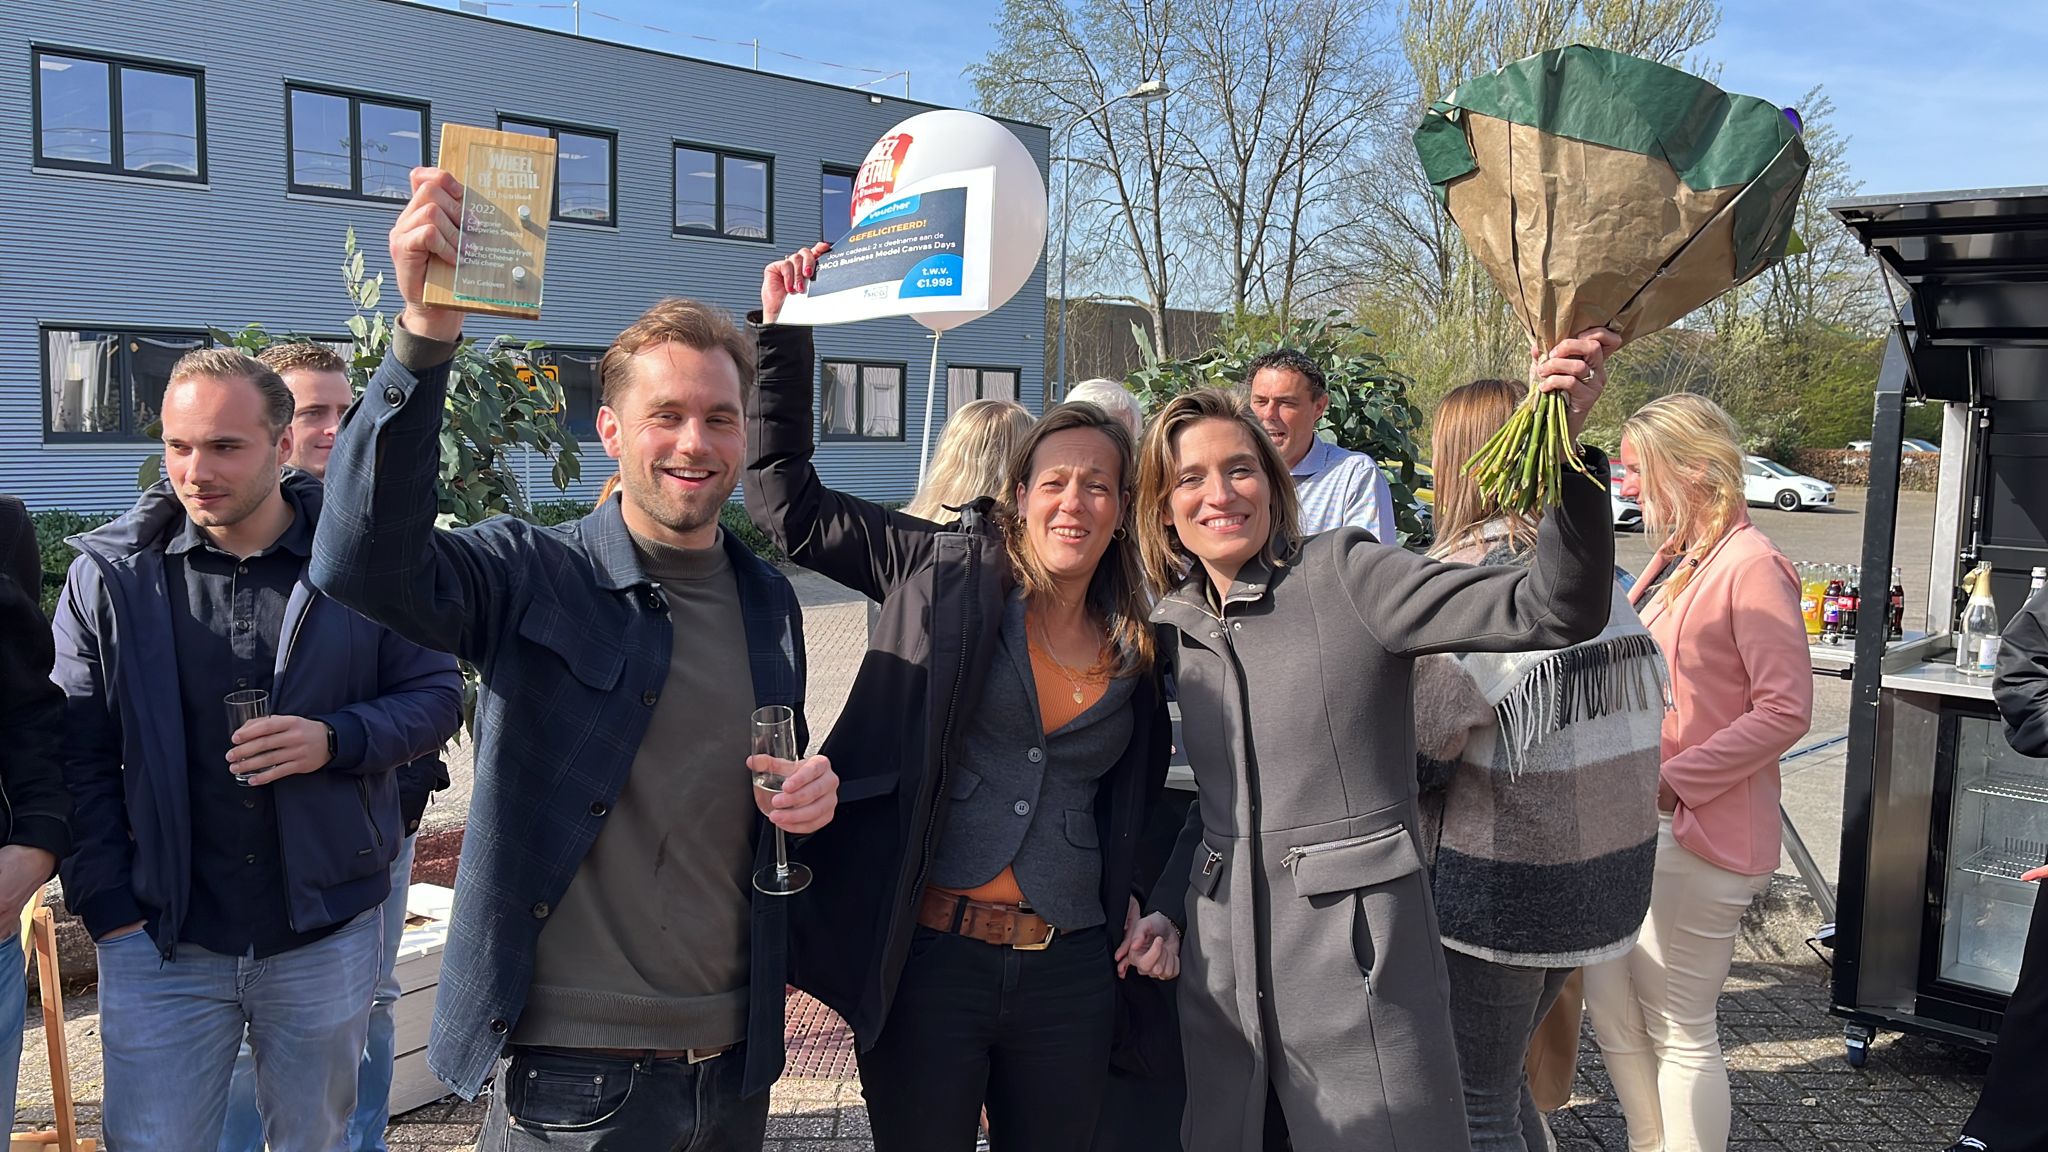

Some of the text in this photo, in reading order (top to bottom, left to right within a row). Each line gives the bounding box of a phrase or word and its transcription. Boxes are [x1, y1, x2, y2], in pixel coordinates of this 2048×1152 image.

[490, 153, 533, 174] WHEEL
[479, 171, 539, 189] OF RETAIL
[470, 203, 497, 215] 2022
[869, 200, 911, 220] voucher
[848, 219, 928, 243] GEFELICITEERD!
[827, 251, 845, 261] Jouw
[872, 242, 878, 250] 2
[883, 236, 918, 248] deelname
[919, 234, 933, 242] aan
[933, 232, 945, 240] de
[839, 251, 874, 267] Business
[875, 246, 901, 259] Model
[901, 243, 933, 254] Canvas
[934, 241, 956, 253] Days
[463, 257, 505, 268] Chili cheese
[464, 250, 488, 260] Nacho
[488, 252, 514, 262] Cheese
[921, 267, 949, 277] t.w.v.
[461, 277, 475, 286] Van
[916, 277, 953, 289] €1.998
